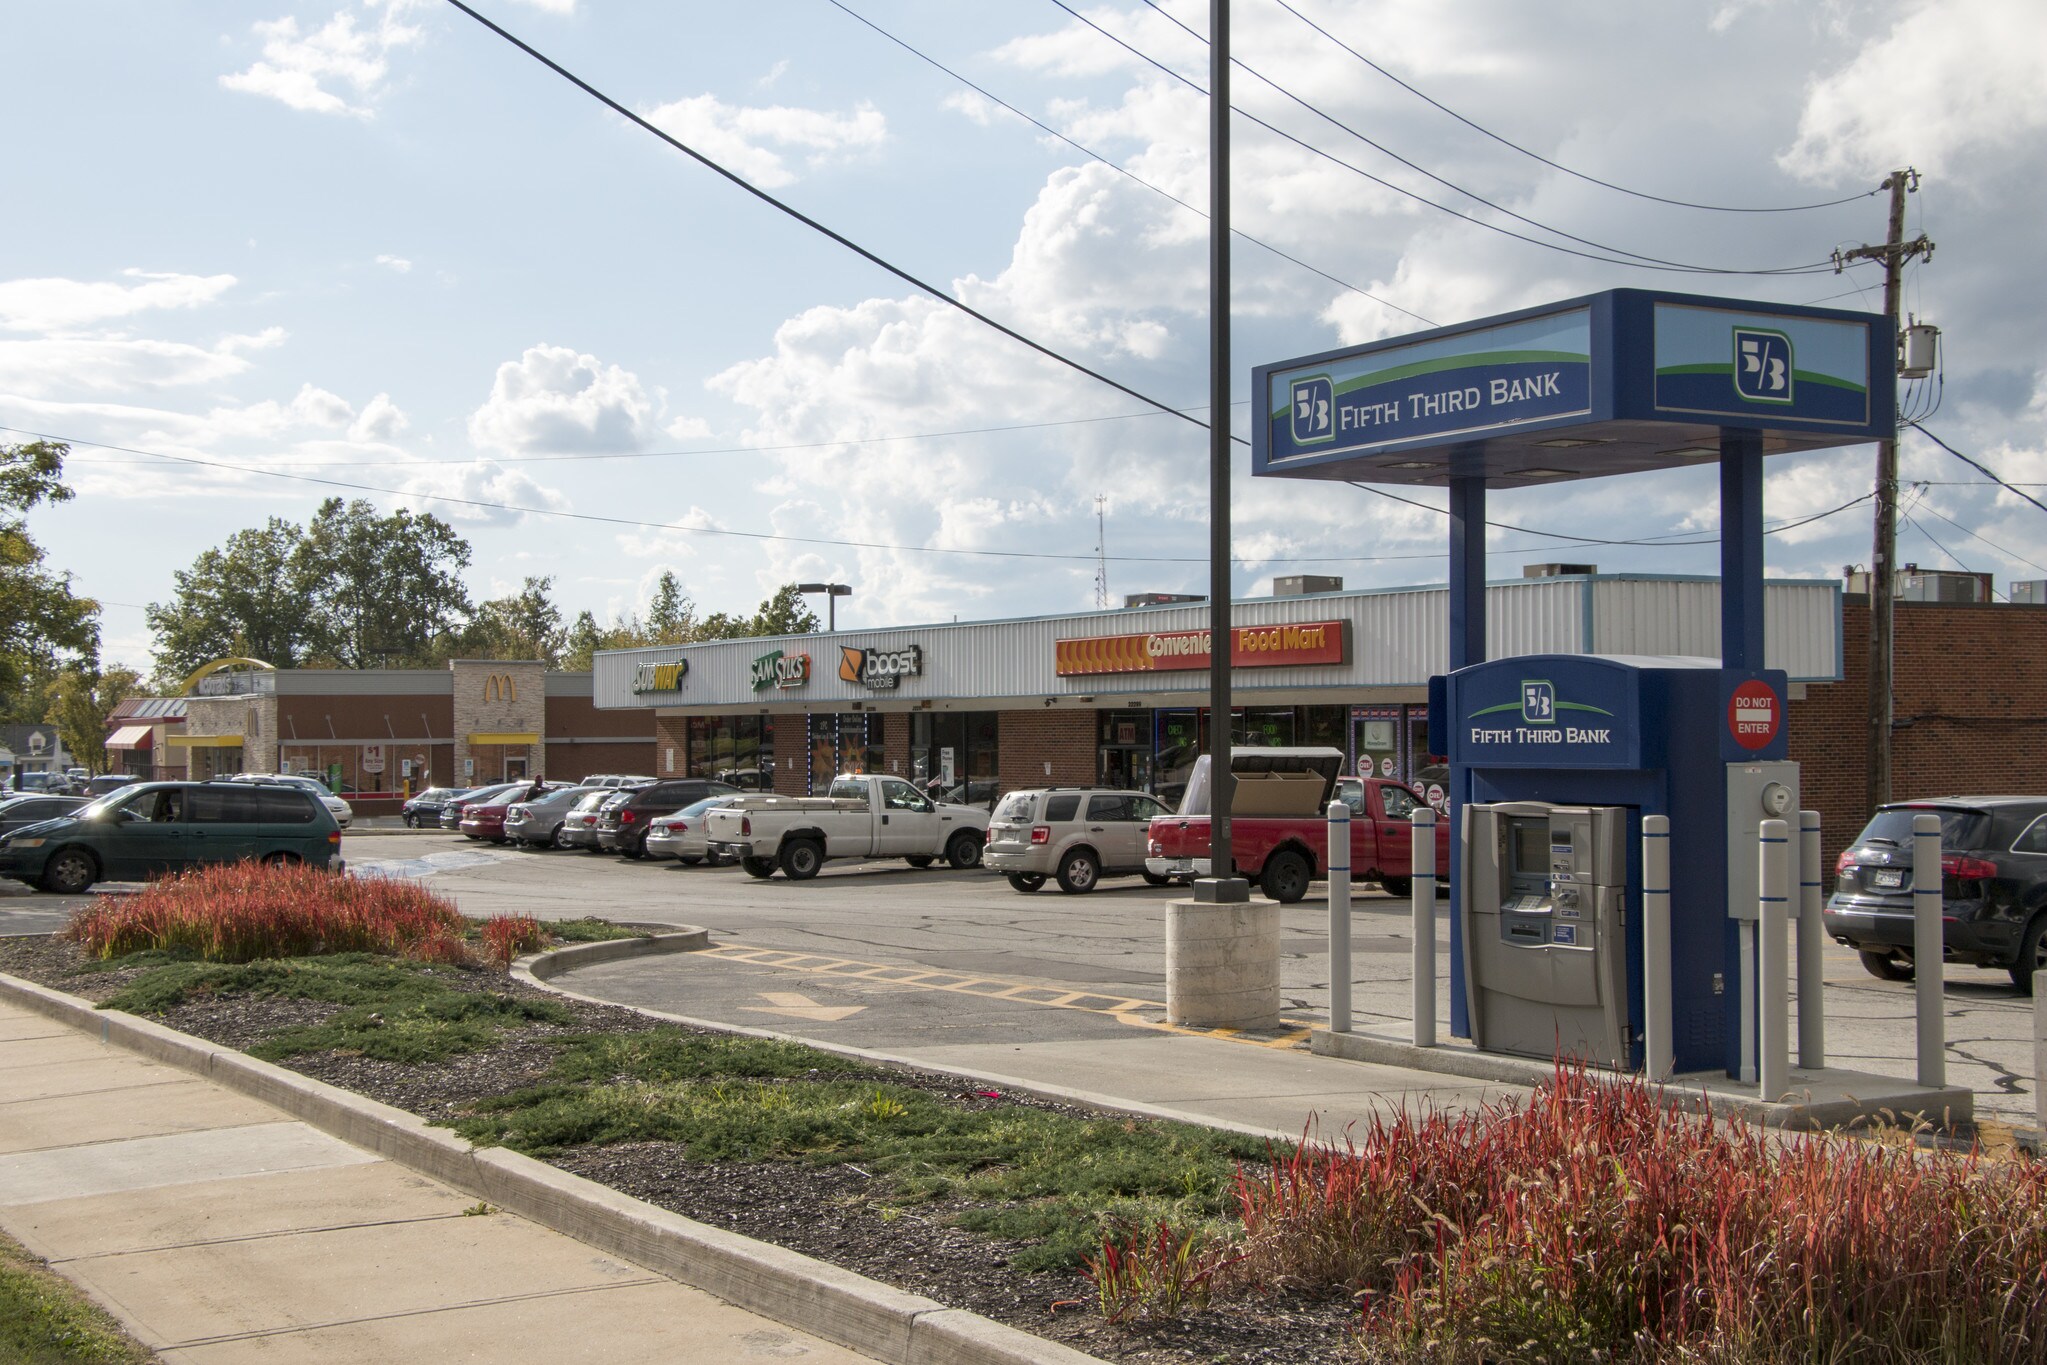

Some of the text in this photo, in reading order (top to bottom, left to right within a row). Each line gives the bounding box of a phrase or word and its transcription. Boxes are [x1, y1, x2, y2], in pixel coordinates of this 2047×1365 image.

[1340, 371, 1561, 431] FIFTH THIRD BANK
[1239, 627, 1281, 652] Food
[1284, 625, 1326, 650] Mart
[866, 645, 917, 676] boost
[632, 663, 684, 692] SUBWAY
[750, 655, 804, 689] SAM SYLKS
[867, 677, 894, 689] mobile
[1736, 697, 1772, 708] DO NOT
[1119, 727, 1135, 741] ATM
[1471, 727, 1611, 744] FIFTH THIRD BANK
[1738, 723, 1770, 734] ENTER
[367, 745, 380, 757] $1
